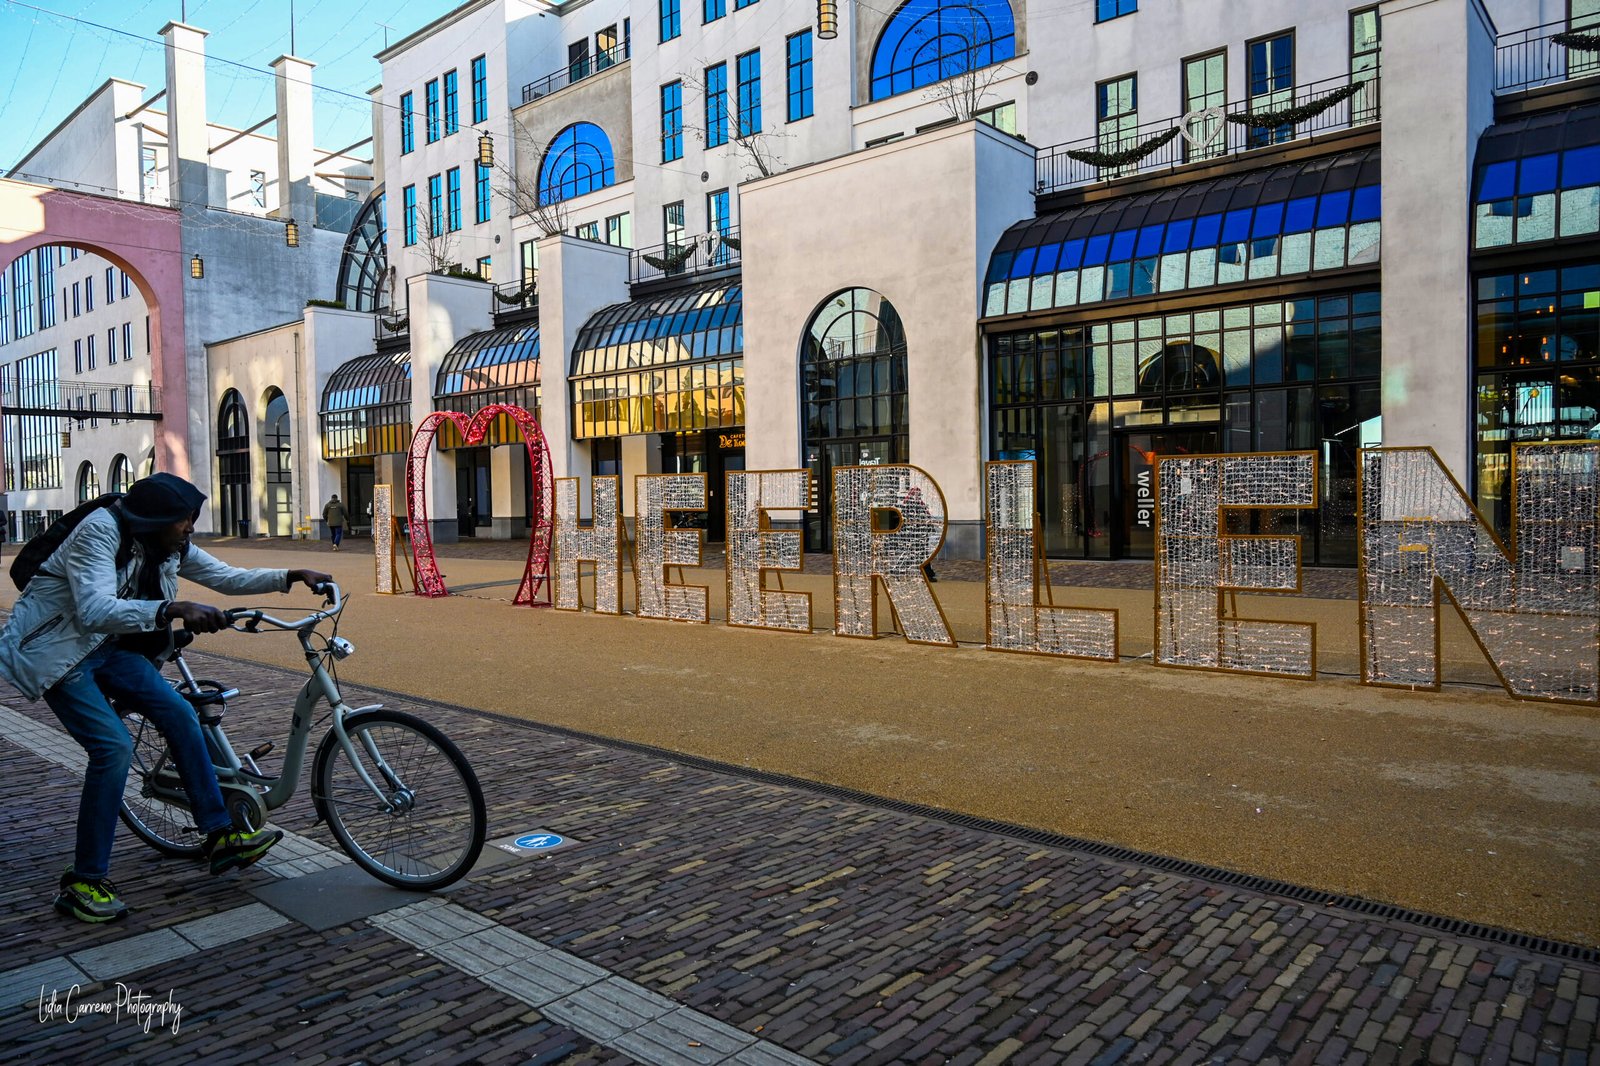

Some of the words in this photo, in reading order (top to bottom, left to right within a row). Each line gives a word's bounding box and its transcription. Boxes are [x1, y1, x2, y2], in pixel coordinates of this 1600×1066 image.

[719, 434, 733, 449] De
[1137, 470, 1155, 528] weller
[554, 440, 1600, 706] HEERLEN
